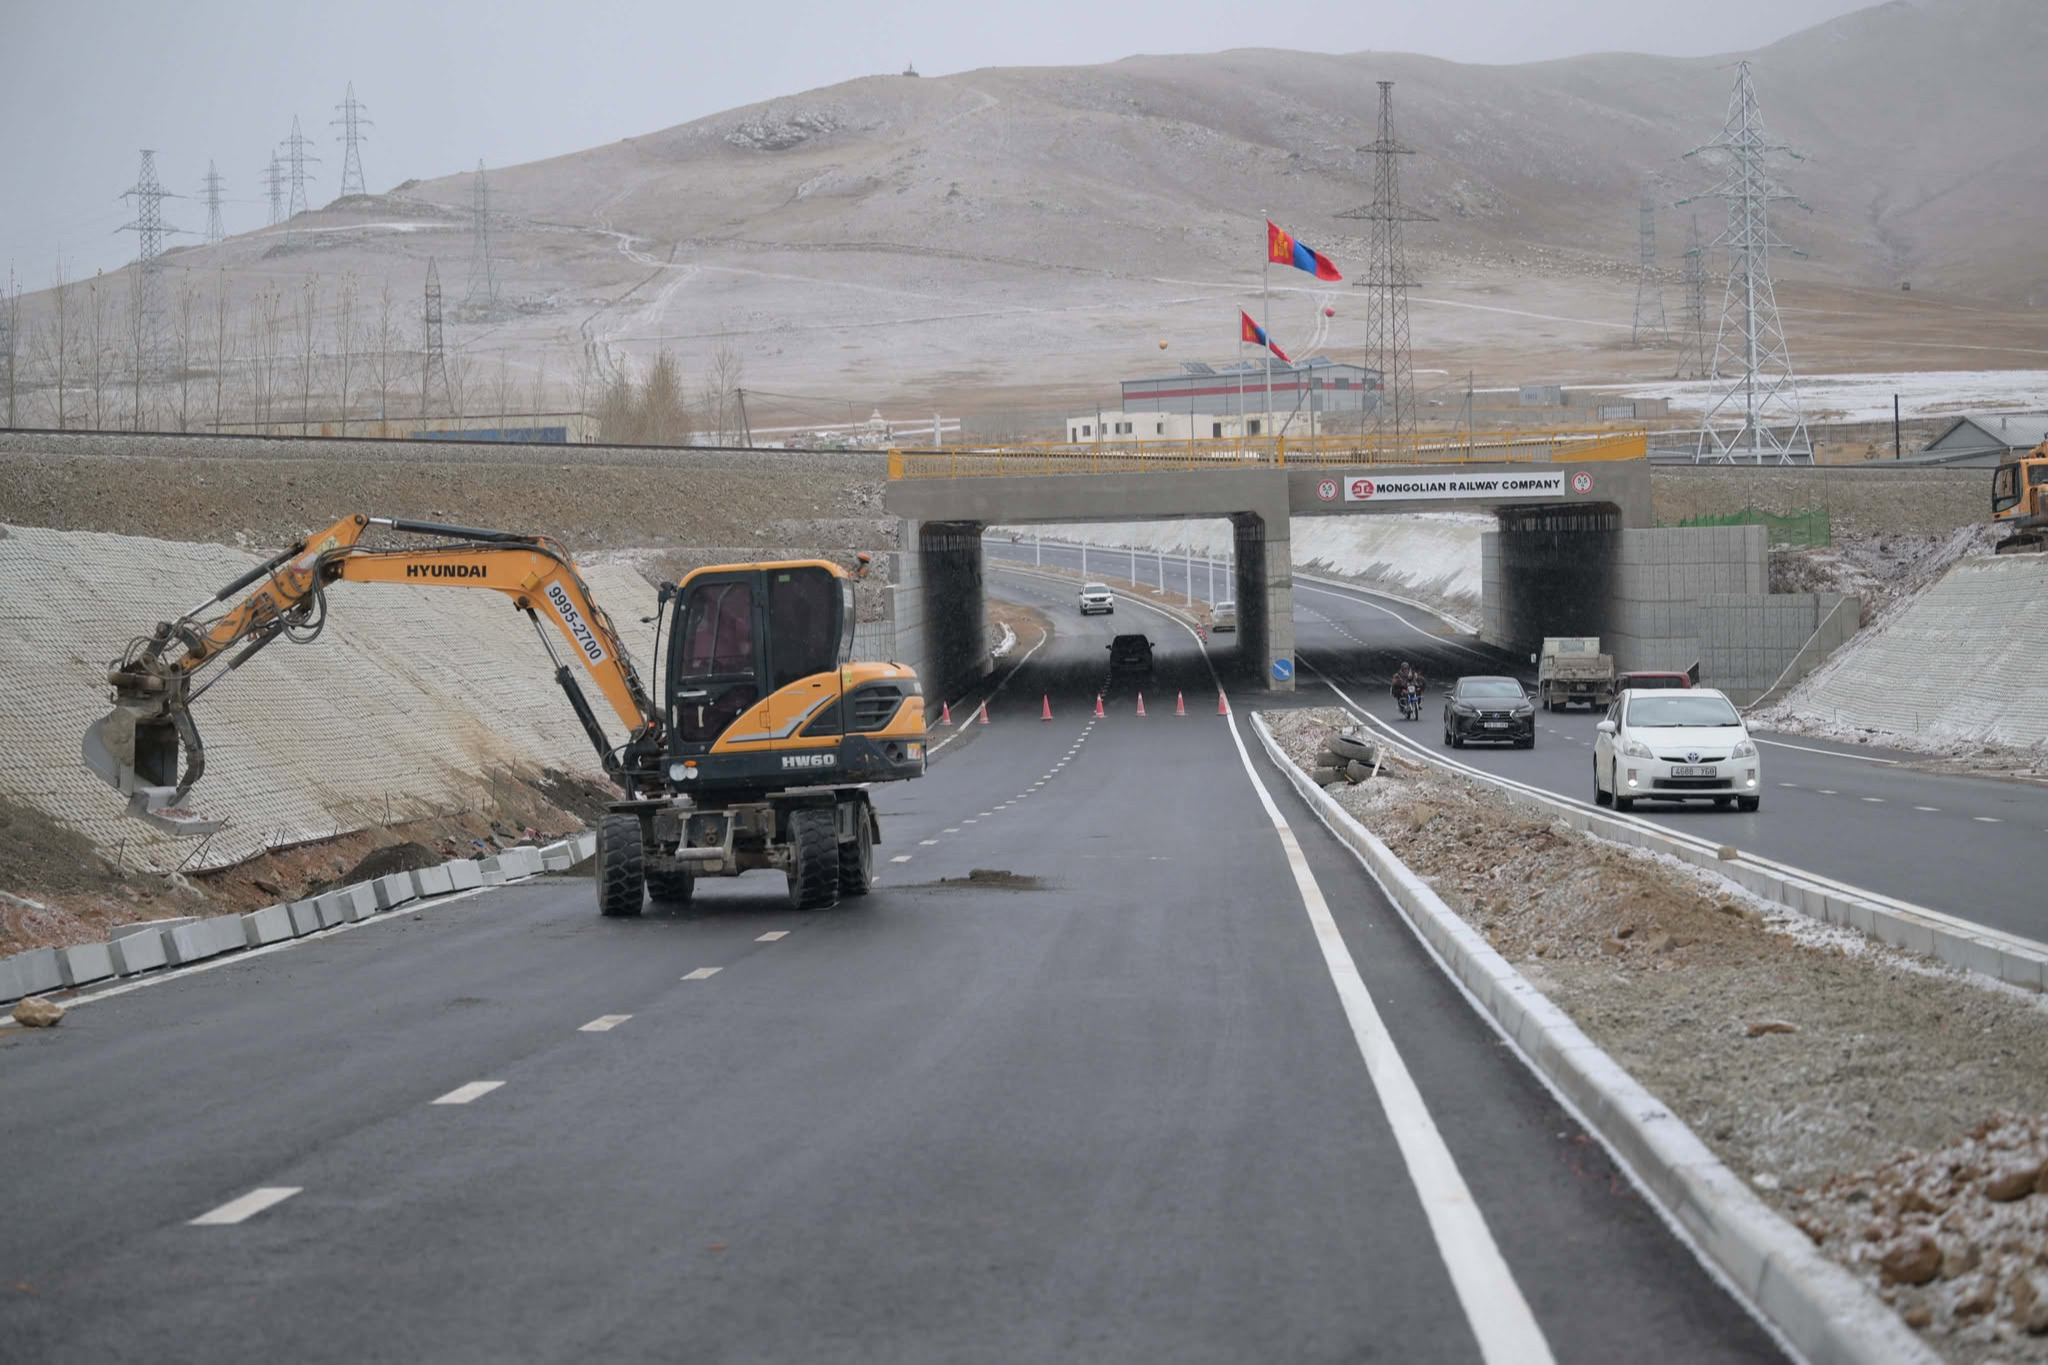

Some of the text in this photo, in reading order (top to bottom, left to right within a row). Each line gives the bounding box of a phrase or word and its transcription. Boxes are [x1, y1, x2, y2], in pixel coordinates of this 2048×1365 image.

[1376, 479, 1561, 494] MONGOLIAN RAILWAY COMPANY
[406, 564, 487, 578] HYUNDAI
[548, 586, 602, 660] 9995-2700
[782, 754, 835, 768] HW60
